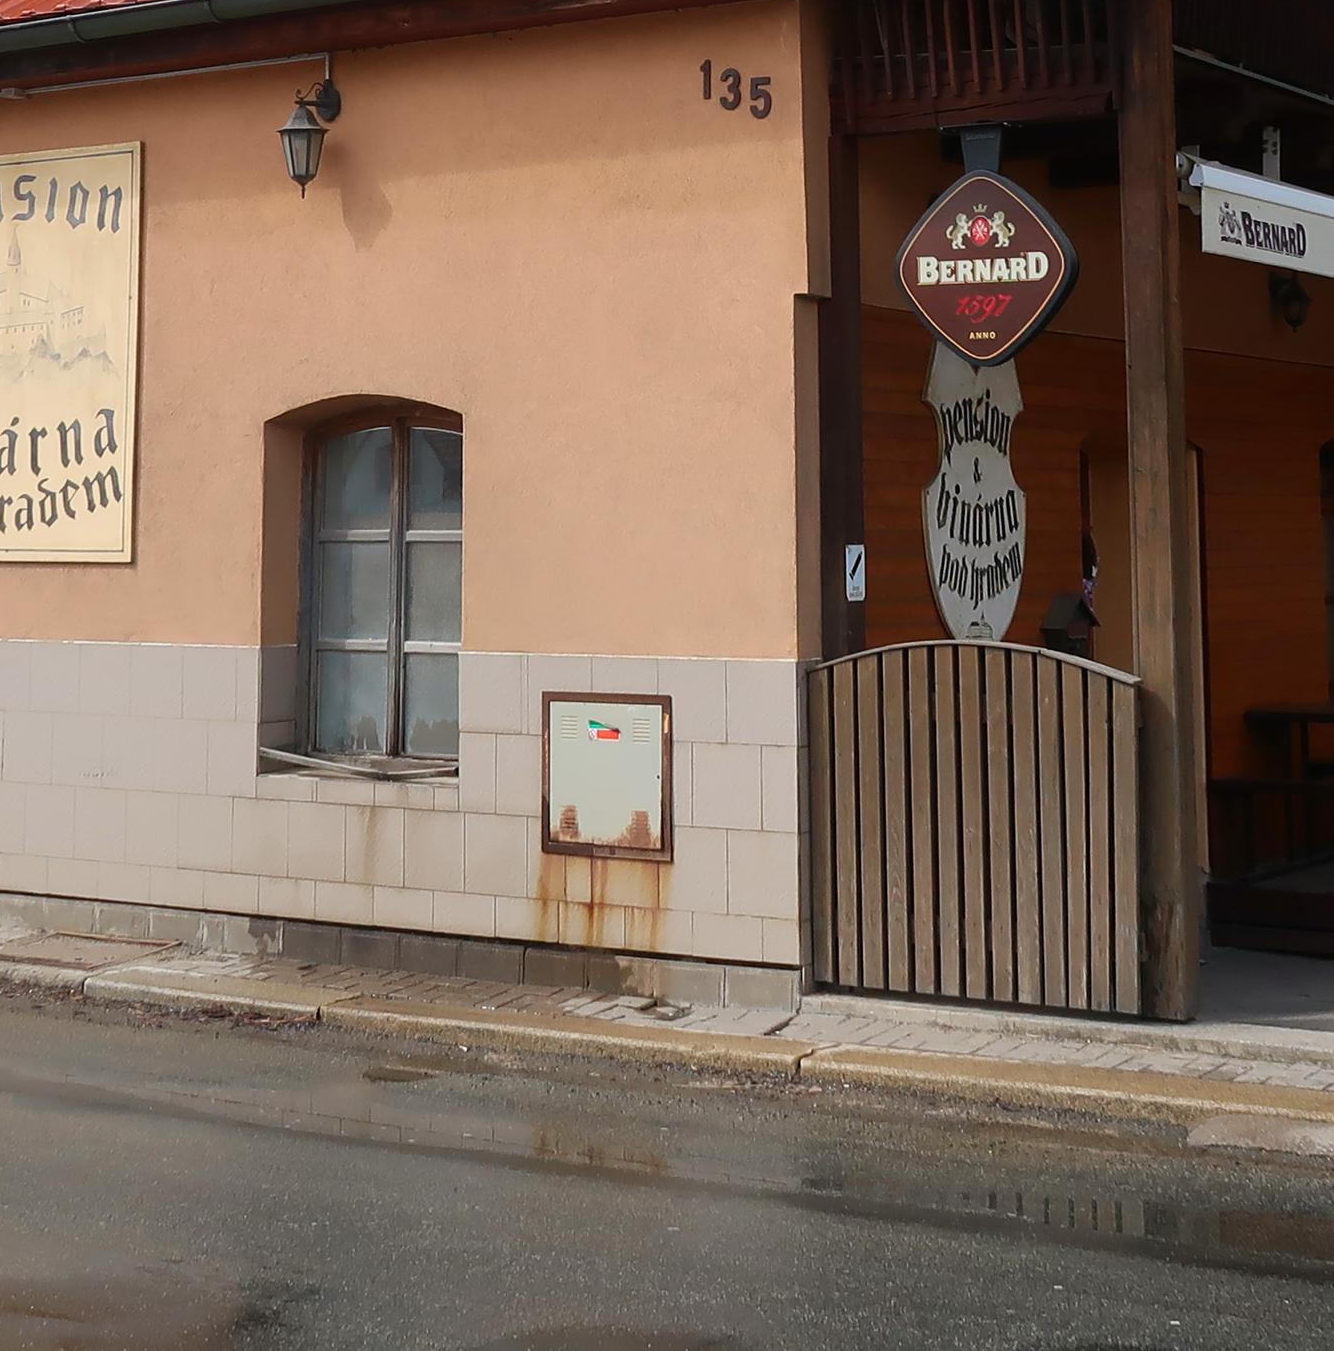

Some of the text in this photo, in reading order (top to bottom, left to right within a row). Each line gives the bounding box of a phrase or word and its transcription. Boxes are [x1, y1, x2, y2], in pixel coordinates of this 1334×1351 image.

[699, 58, 772, 119] 135
[1241, 211, 1307, 258] BERNARD
[917, 251, 1049, 285] BERNARD
[955, 293, 1013, 324] 1597
[969, 331, 997, 340] ANNO
[940, 388, 1010, 468] pension
[973, 457, 983, 484] &
[939, 542, 1022, 610] pod hradem
